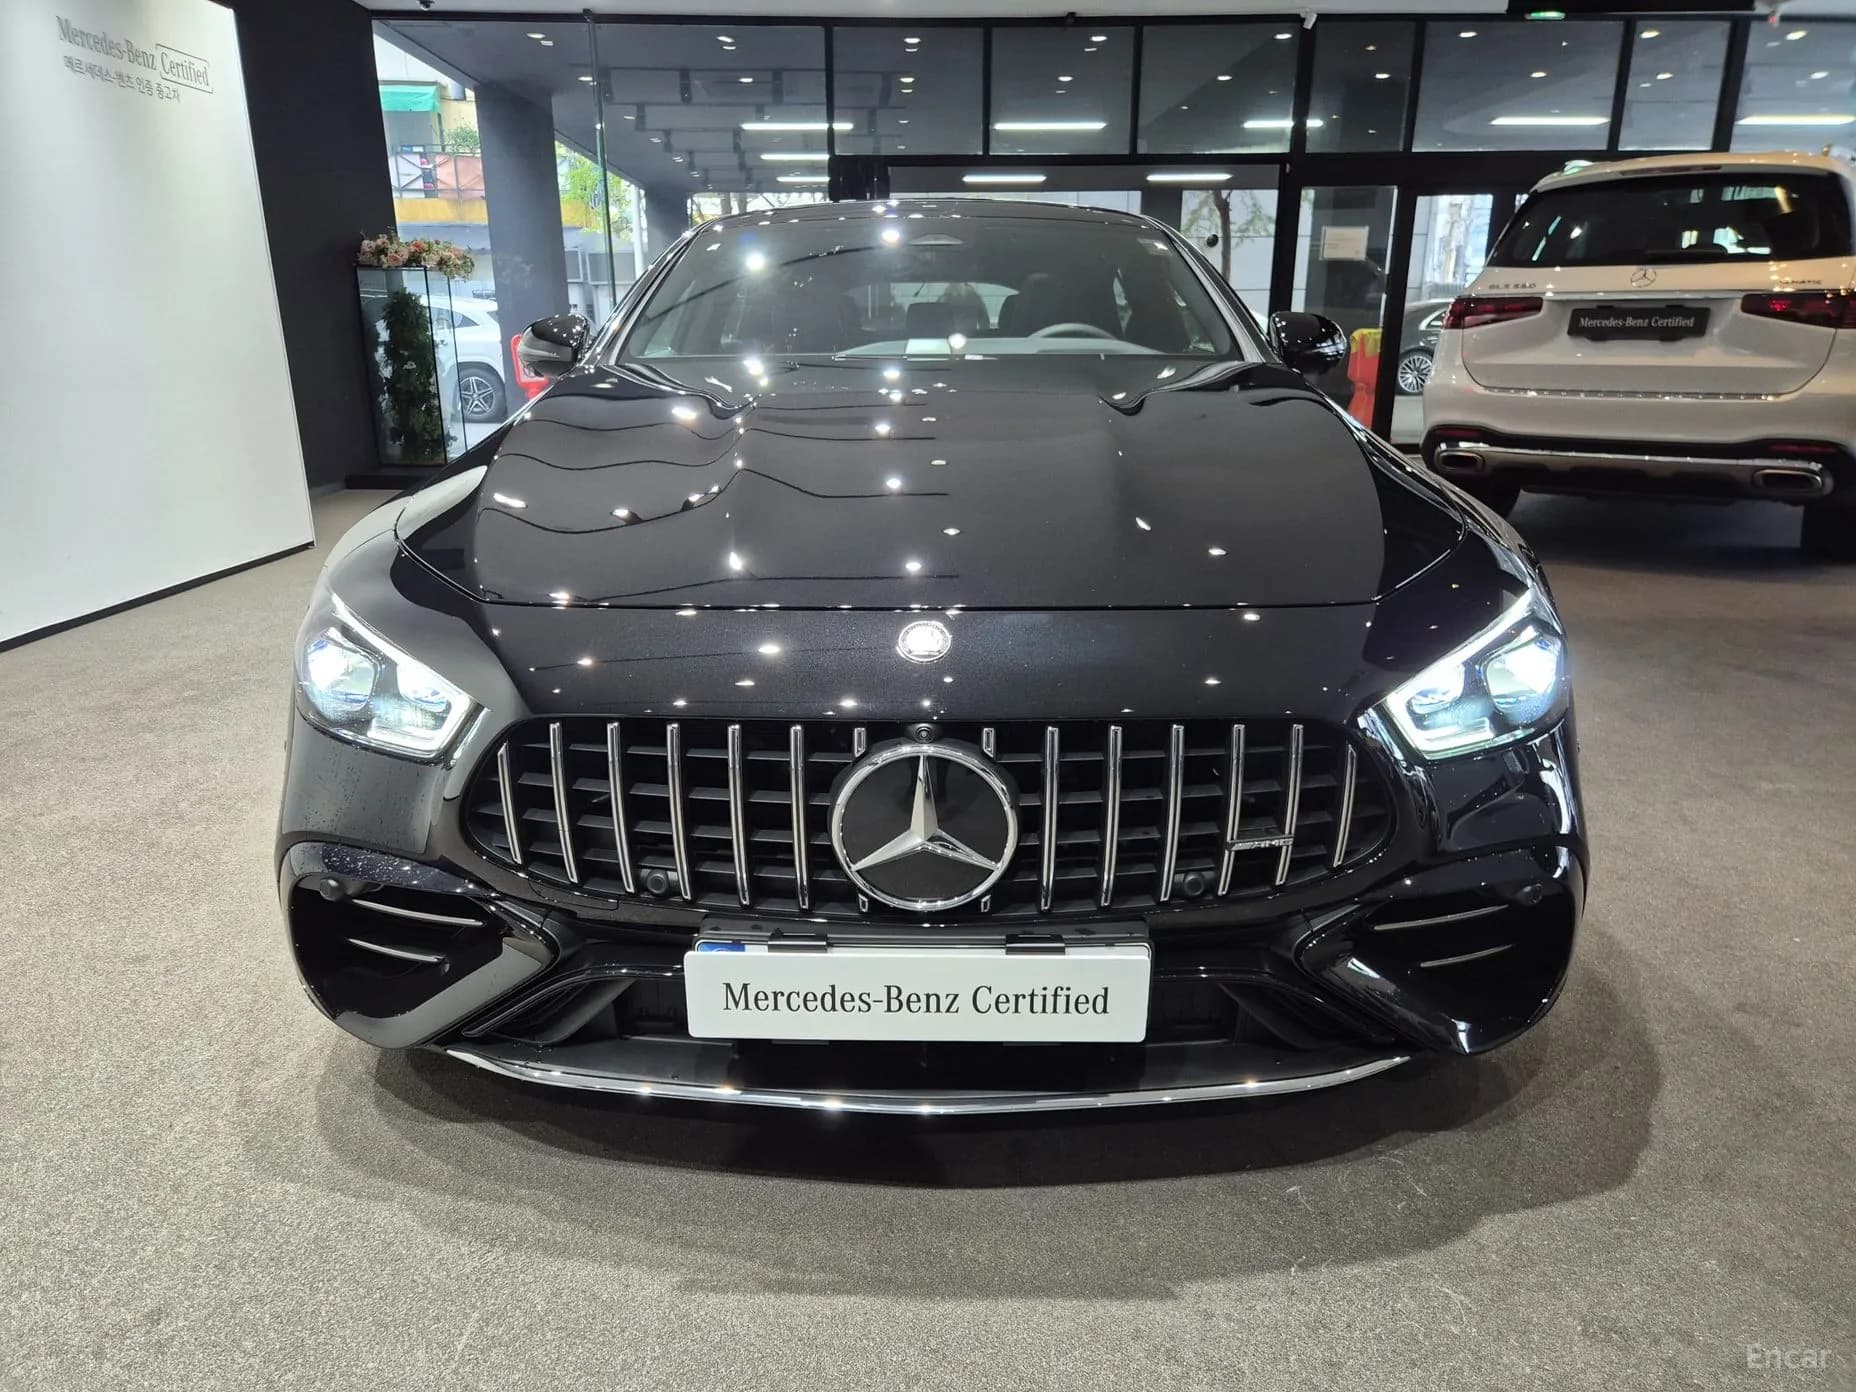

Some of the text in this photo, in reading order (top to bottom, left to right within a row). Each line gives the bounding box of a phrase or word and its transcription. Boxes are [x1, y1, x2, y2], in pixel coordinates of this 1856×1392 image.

[56, 15, 209, 87] Mercedes-Benz Certified
[135, 76, 153, 97] 인증
[155, 83, 181, 104] 중고차
[1579, 315, 1695, 328] Mercedes-Benz Certified
[721, 981, 1110, 1017] Mercedes-Benz Certified
